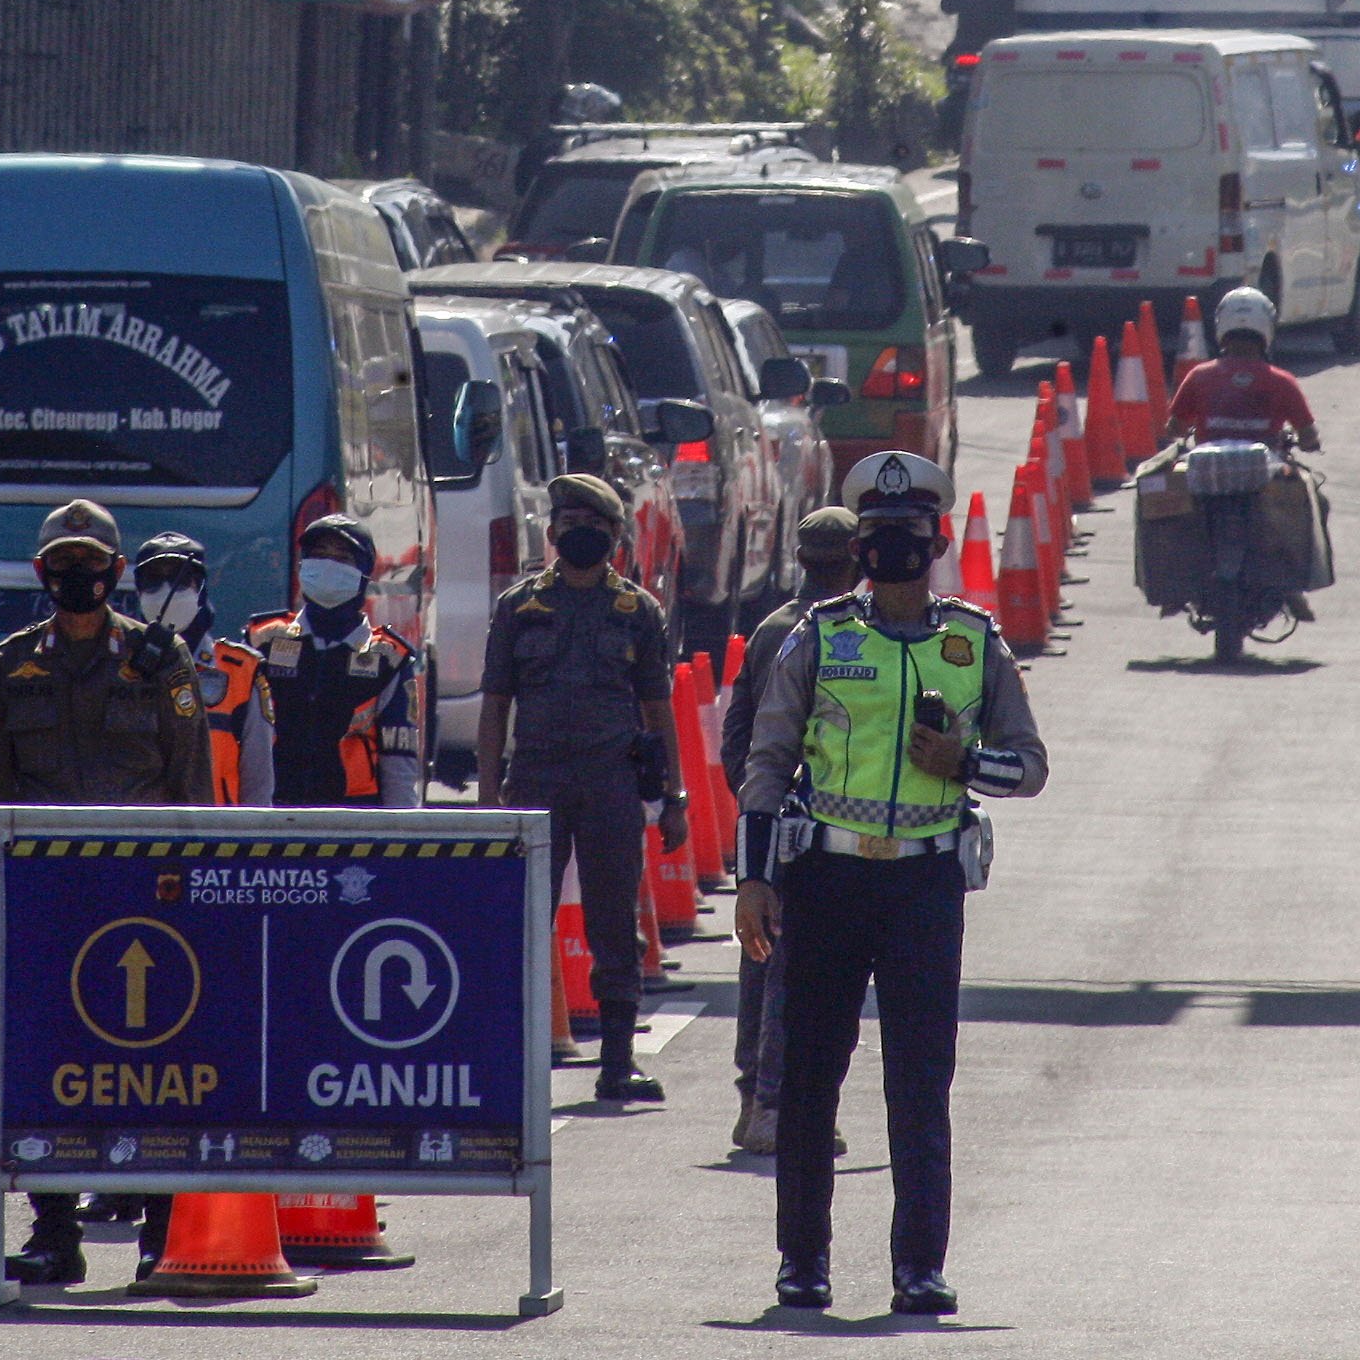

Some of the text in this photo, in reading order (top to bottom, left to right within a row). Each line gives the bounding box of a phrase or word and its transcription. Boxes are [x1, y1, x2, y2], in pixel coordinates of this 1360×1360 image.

[105, 314, 233, 408] ARRAHMA
[31, 407, 118, 432] Citeureup
[171, 408, 222, 432] Bogor
[190, 869, 329, 887] SAT LANTAS
[190, 889, 328, 904] POLRES BOGOR
[52, 1063, 218, 1106] GENAP
[307, 1063, 481, 1107] GANJIL
